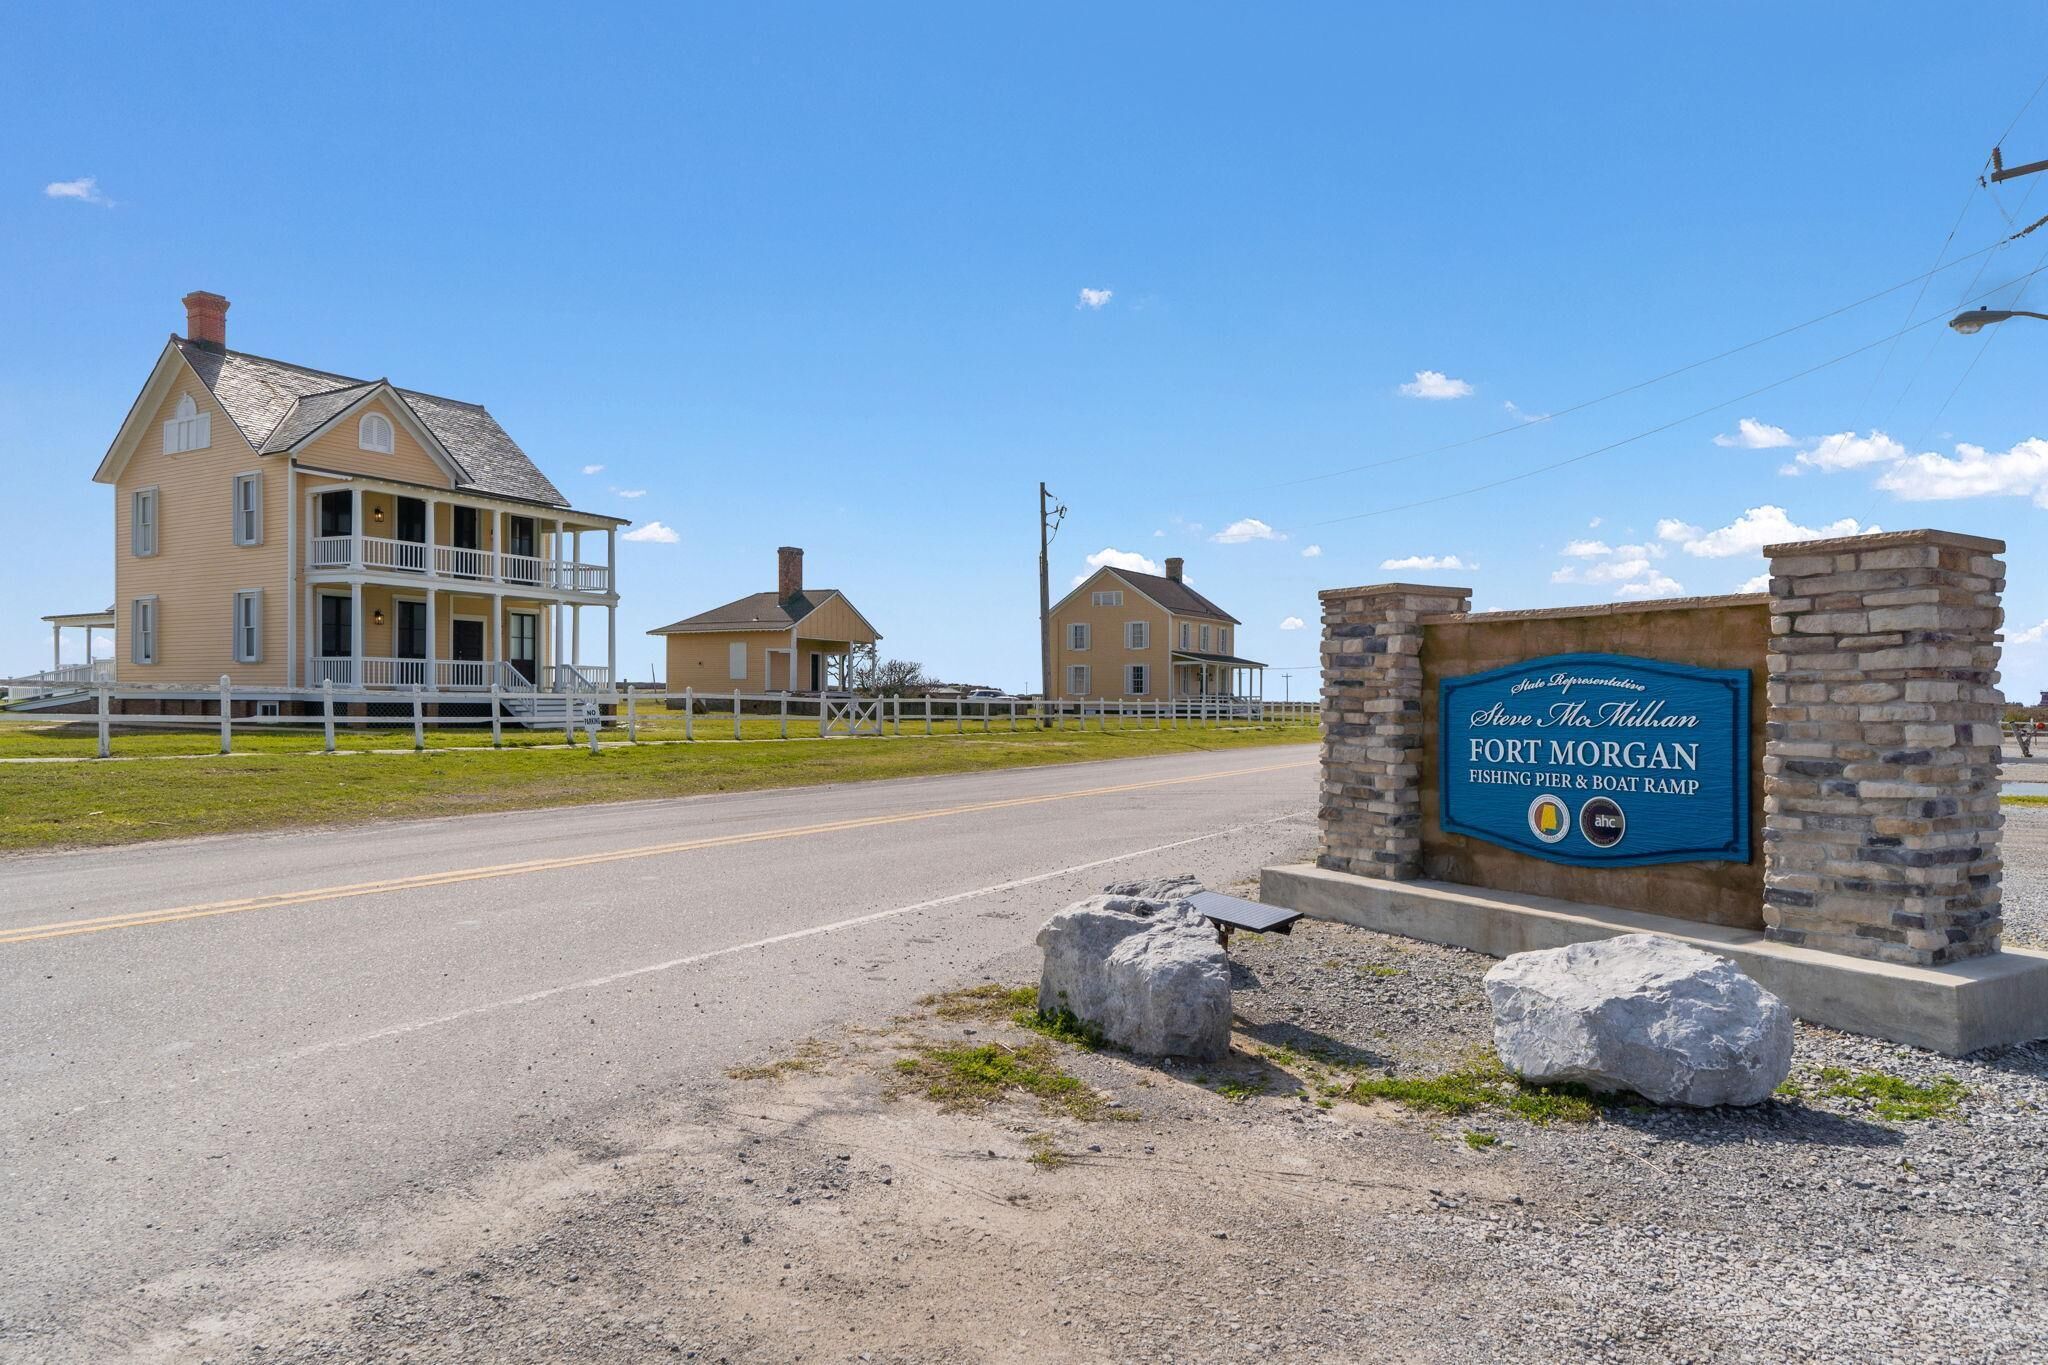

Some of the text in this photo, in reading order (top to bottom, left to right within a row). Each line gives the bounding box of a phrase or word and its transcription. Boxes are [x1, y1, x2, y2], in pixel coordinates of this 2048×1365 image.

[1511, 672, 1646, 695] State Representative
[1469, 702, 1533, 729] Steve
[1469, 738, 1699, 770] FORT MORGAN
[1469, 769, 1699, 795] FISHING PIER & BOAT RAMP
[1595, 814, 1616, 828] ahc
